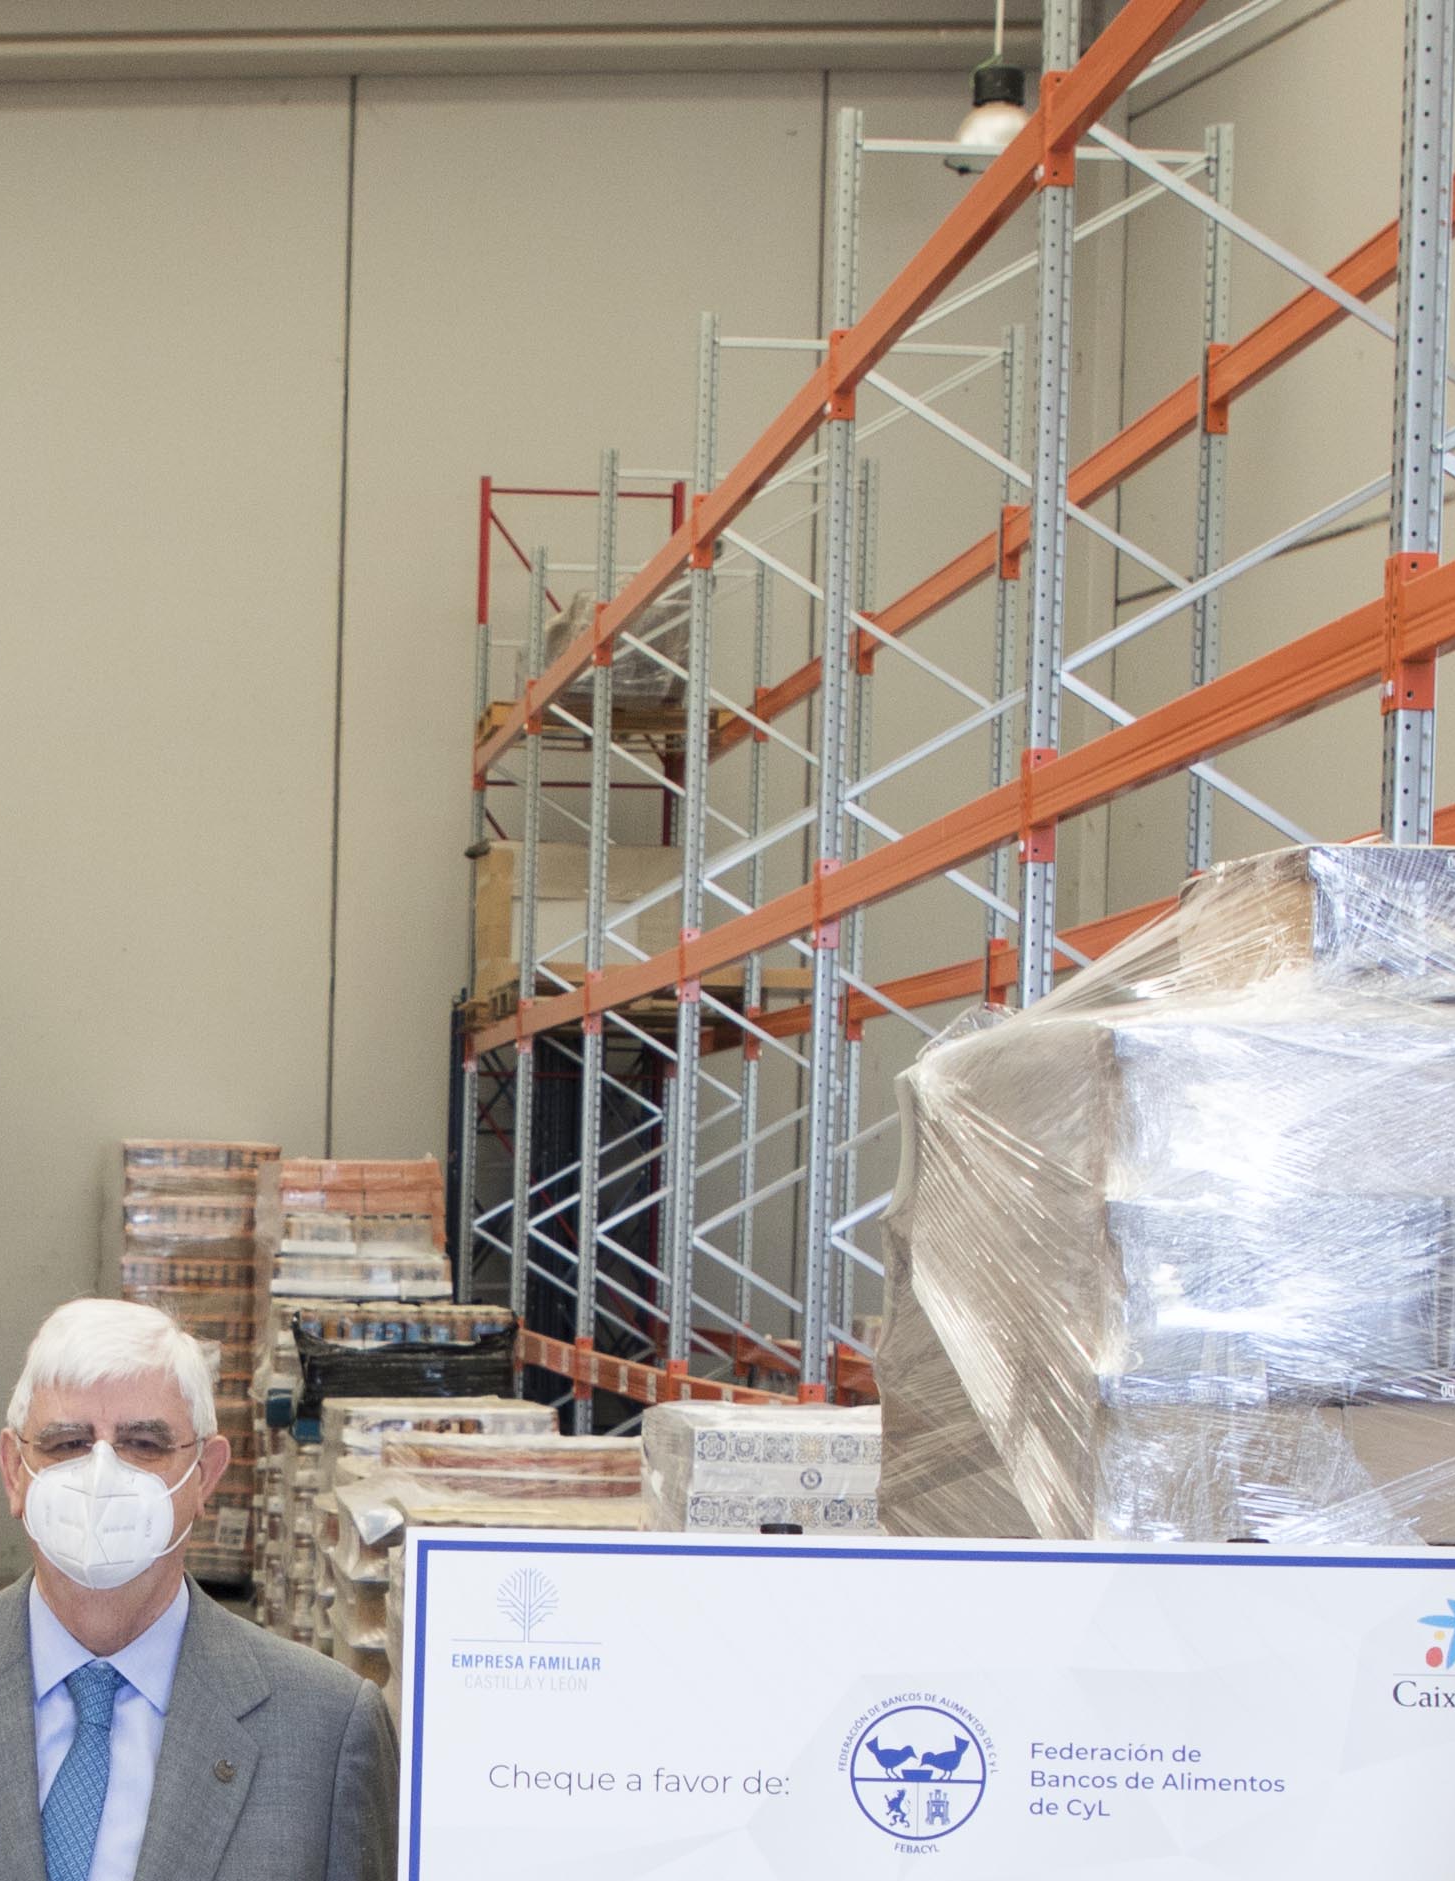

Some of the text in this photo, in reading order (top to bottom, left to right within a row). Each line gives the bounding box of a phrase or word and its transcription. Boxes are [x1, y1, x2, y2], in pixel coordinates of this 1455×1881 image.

[451, 1652, 602, 1672] EMPRESA FAMILIAR
[463, 1673, 589, 1693] CASTILLA Y LEÓN
[837, 1692, 997, 1773] FEDERACIÓN DE BANCOS DE ALIMENTOS DE
[1030, 1742, 1203, 1764] Federación de
[488, 1763, 791, 1797] Cheque a favor de:
[1030, 1769, 1286, 1794] Bancos de Alimentos
[1029, 1796, 1111, 1821] de CyL
[893, 1841, 941, 1855] FEBACYL
